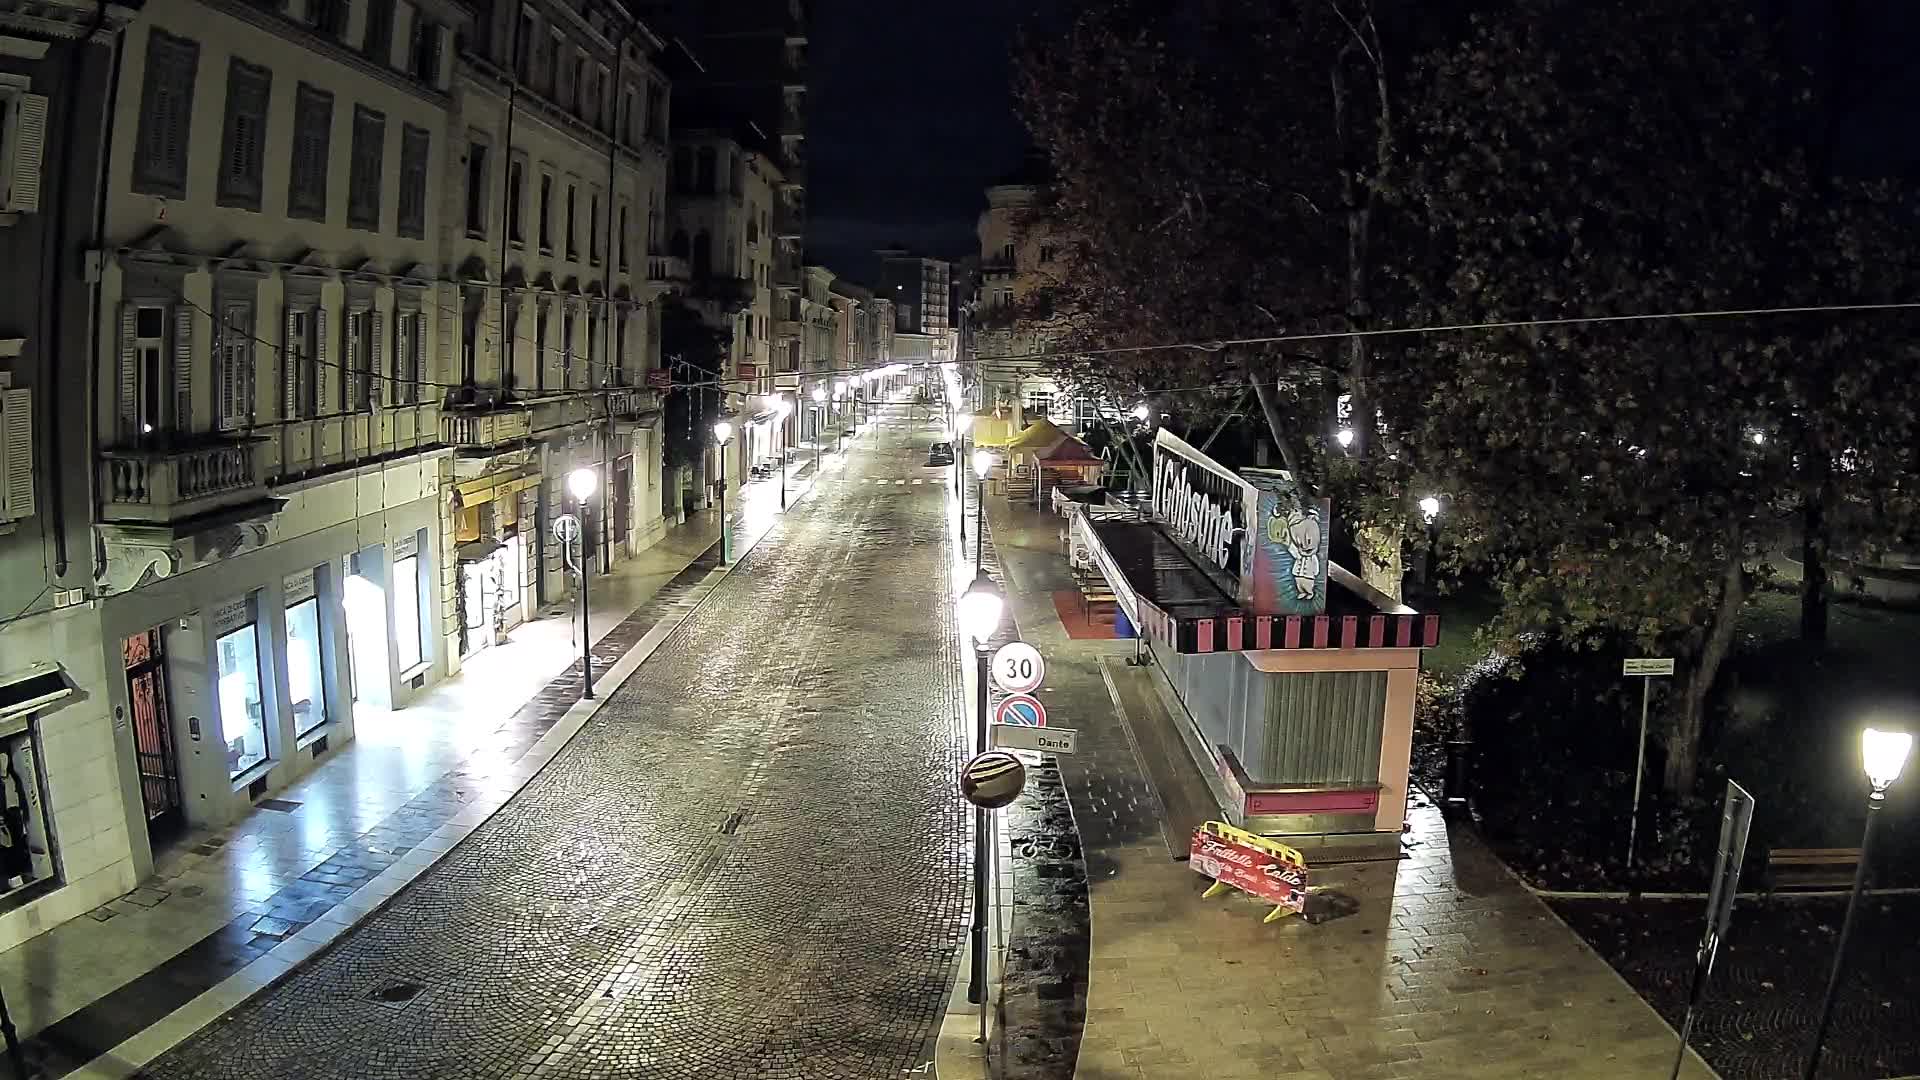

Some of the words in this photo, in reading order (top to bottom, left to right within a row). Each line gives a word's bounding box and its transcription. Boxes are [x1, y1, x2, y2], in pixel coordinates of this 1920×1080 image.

[1162, 458, 1233, 570] Golosone
[1006, 658, 1032, 679] 30
[1038, 737, 1070, 749] Dante
